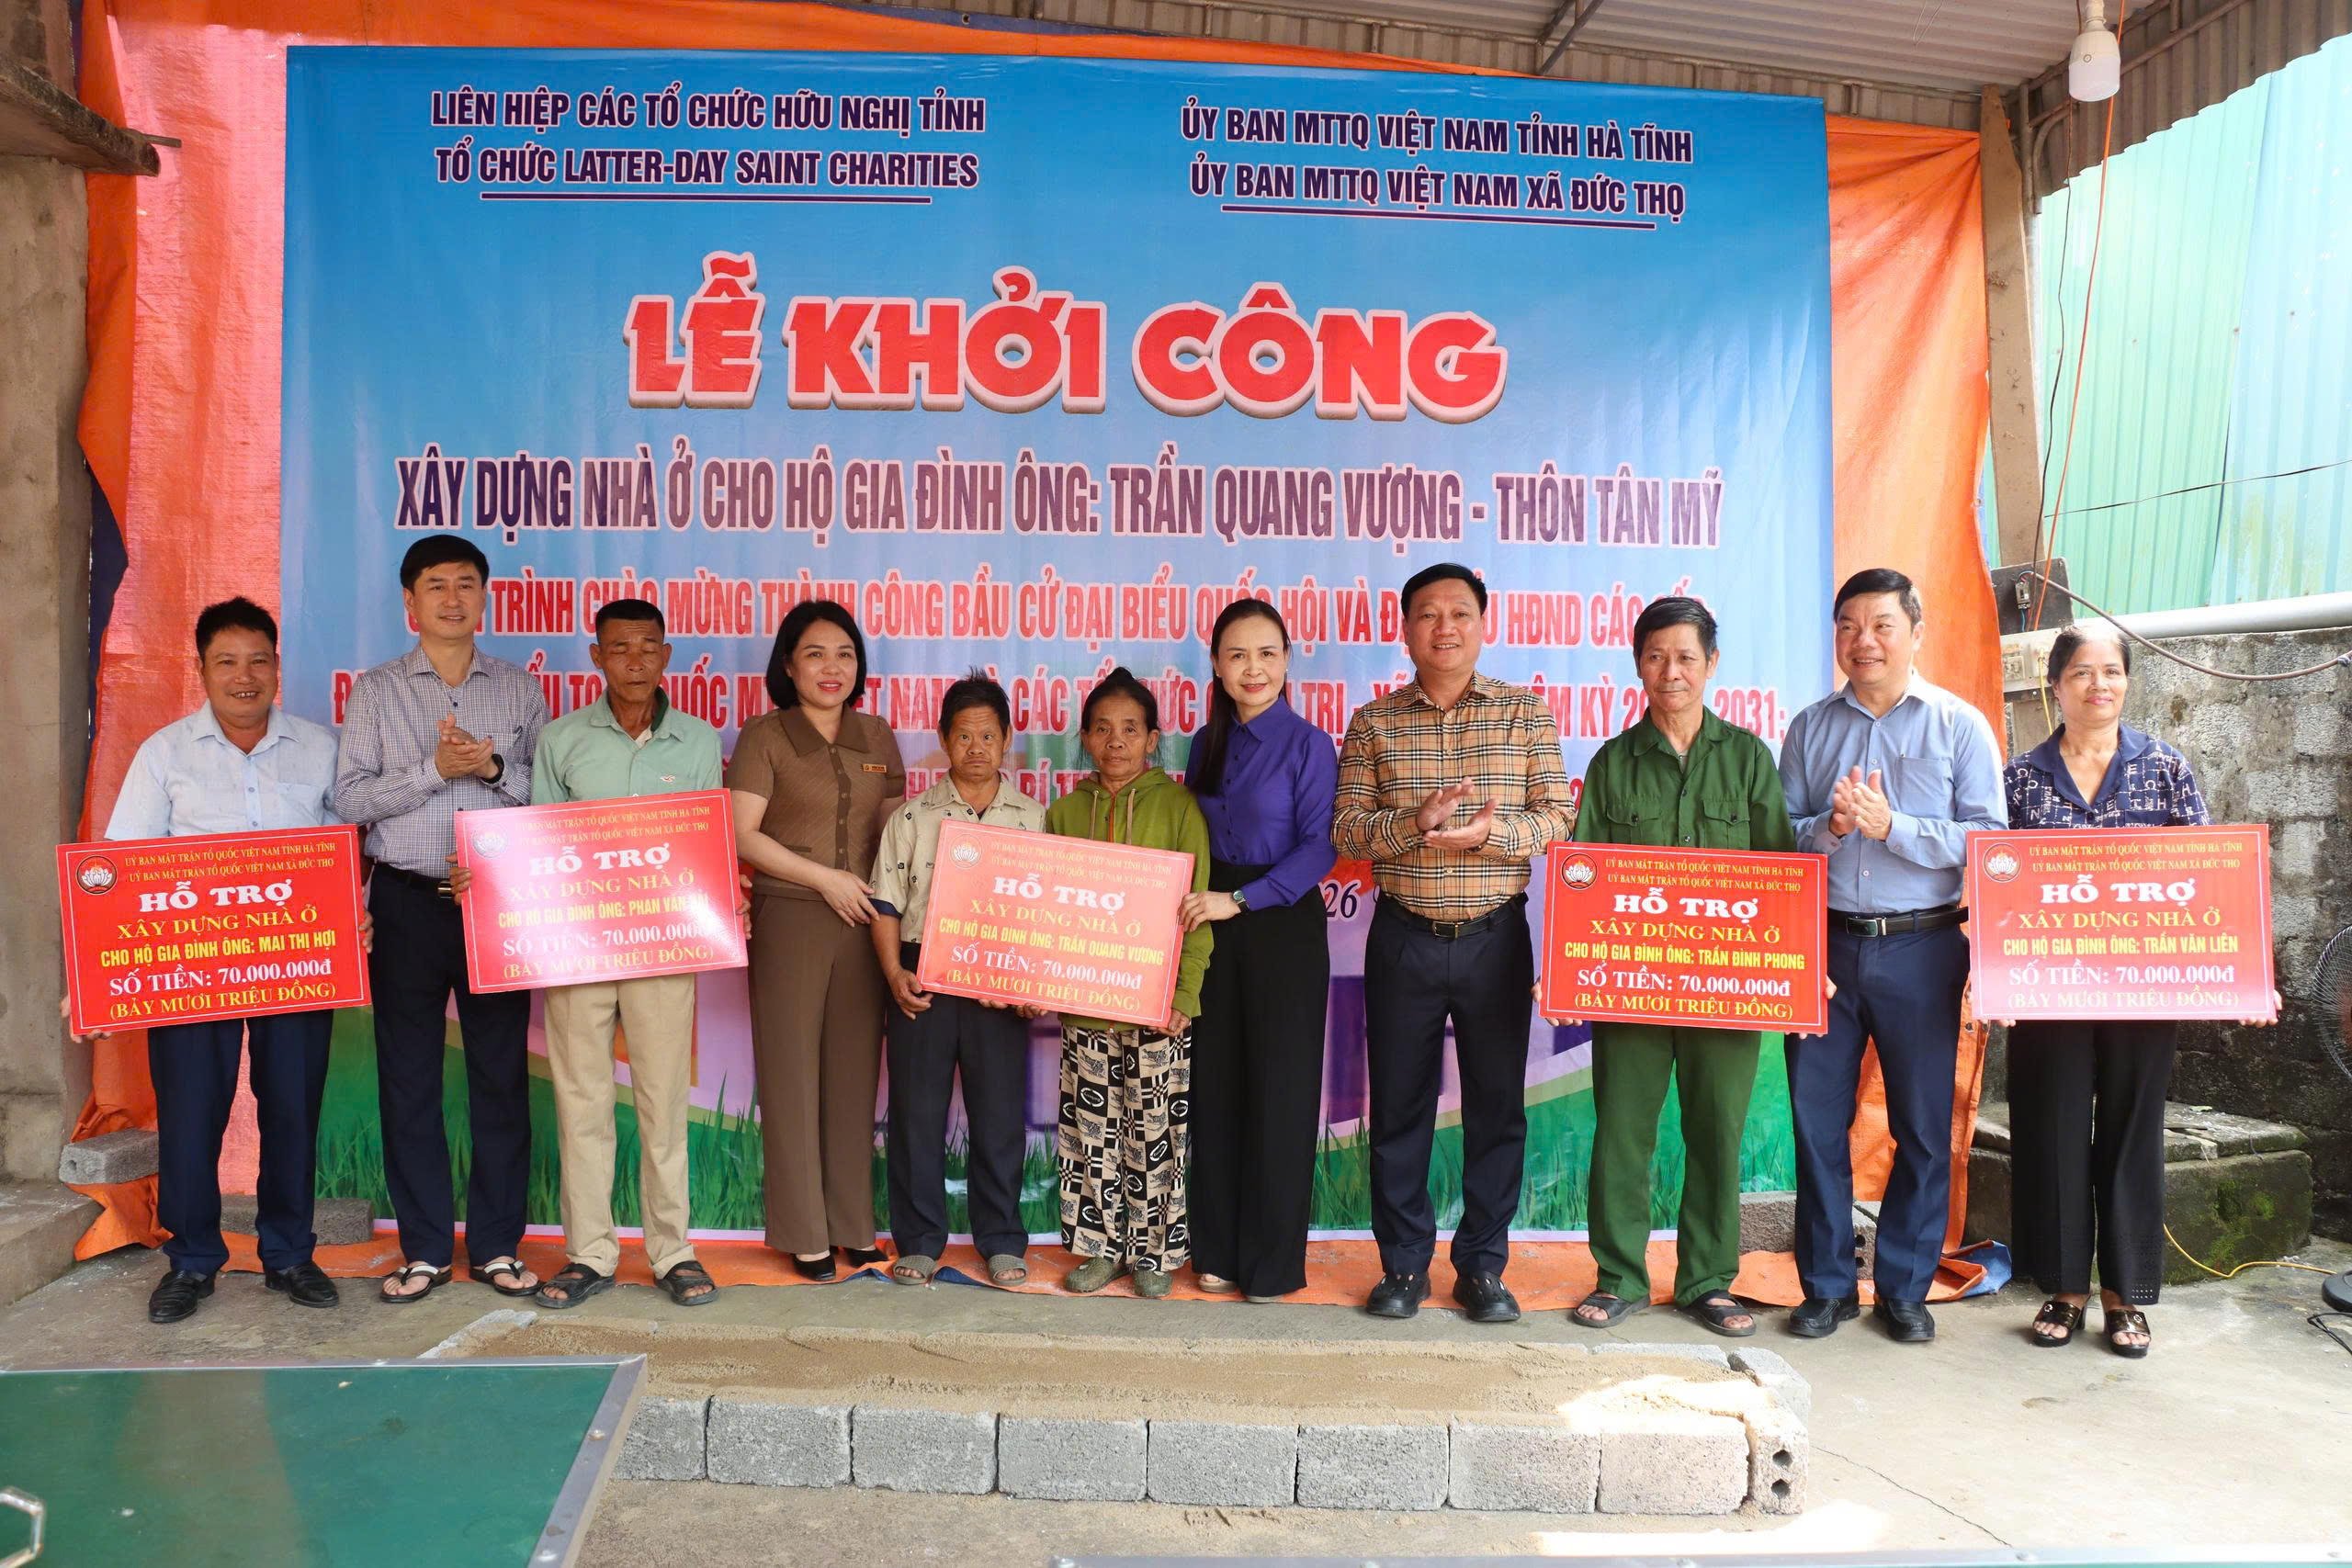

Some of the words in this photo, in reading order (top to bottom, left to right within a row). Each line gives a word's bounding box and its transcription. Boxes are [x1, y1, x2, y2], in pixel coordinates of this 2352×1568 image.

[431, 85, 499, 127] LIÊN
[503, 86, 571, 134] HIỆP
[577, 82, 636, 130] CÁC
[643, 80, 683, 130] TỔ
[688, 86, 765, 130] CHỨC
[772, 88, 833, 130] HỮU
[840, 95, 911, 139] NGHỊ
[919, 85, 986, 132] TỈNH
[1182, 95, 1220, 141] ỦY
[1226, 108, 1286, 143] BAN
[1294, 110, 1370, 152] MTTQ
[1376, 108, 1435, 155] VIỆT
[1443, 118, 1510, 154] NAM
[1516, 110, 1579, 158] TỈNH
[1586, 116, 1624, 161] HÀ
[1630, 121, 1693, 164] TĨNH
[434, 135, 472, 184] TỔ
[478, 142, 557, 184] CHỨC
[562, 148, 728, 186] LATTER-DAY
[735, 150, 821, 186] SAINT
[828, 152, 979, 189] CHARITIES
[1190, 152, 1227, 197] ỦY
[1235, 164, 1295, 199] BAN
[1303, 166, 1379, 207] MTTQ
[1385, 164, 1445, 211] VIỆT
[1453, 174, 1520, 209] NAM
[1524, 168, 1564, 210] XÃ
[1569, 172, 1627, 214] ĐỨC
[1633, 182, 1685, 223] THỌ
[625, 251, 761, 407] LỄ
[784, 265, 1107, 412] KHỞI
[1132, 282, 1508, 423] CÔNG
[396, 444, 467, 528] XÂY
[475, 451, 573, 543] DỰNG
[582, 444, 658, 529] NHÀ
[667, 436, 695, 530] Ở
[701, 459, 774, 531] CHO
[784, 445, 835, 547] HỘ
[845, 461, 907, 532] GIA
[913, 446, 1005, 533] ĐÌNH
[1013, 448, 1101, 536] ÔNG:
[1108, 441, 1205, 536] TRẦN
[1213, 467, 1332, 544] QUANG
[1342, 463, 1463, 555] VƯỢNG
[1493, 461, 1587, 544] THÔN
[1594, 462, 1663, 547] TÂN
[1669, 467, 1726, 548] MỸ
[489, 567, 575, 636] TRÌNH
[666, 568, 755, 637] MỪNG
[863, 569, 944, 639] CÔNG
[952, 563, 1011, 639] BẦU
[1018, 563, 1062, 640] CỬ
[1064, 582, 1114, 652] ĐẠI
[1120, 562, 1188, 641] BIỂU
[1280, 576, 1329, 655] HỘI
[1334, 577, 1374, 644] VÀ
[1011, 665, 1070, 733] CÁC
[1578, 674, 1617, 739] KỲ
[526, 846, 582, 878] HỖ
[593, 843, 670, 870] TRỢ
[1618, 859, 1634, 868] BAN
[1732, 864, 1750, 874] NAM
[140, 881, 198, 912] HỖ
[209, 879, 292, 906] TRỢ
[628, 868, 673, 890] NHÀ
[678, 868, 694, 887] Ở
[993, 873, 1043, 898] HỖ
[1054, 886, 1125, 915] TRỢ
[2041, 874, 2098, 903] HỖ
[2110, 878, 2195, 906] TRỢ
[970, 898, 1011, 917] XÂY
[1016, 907, 1071, 926] DỰNG
[1078, 915, 1118, 933] NHÀ
[1126, 919, 1140, 937] Ở
[1323, 880, 1359, 919] 26
[1614, 887, 1668, 914] HỖ
[1679, 898, 1758, 923] TRỢ
[118, 919, 165, 939] XÂY
[174, 915, 238, 935] DỰNG
[246, 907, 294, 927] NHÀ
[301, 905, 317, 922] Ở
[1590, 918, 1636, 935] XÂY
[1643, 923, 1703, 941] DỰNG
[1712, 925, 1757, 942] NHÀ
[1764, 926, 1780, 942] Ở
[2019, 909, 2065, 928] XÂY
[2073, 911, 2139, 931] DỰNG
[2146, 908, 2196, 926] NHÀ
[2203, 907, 2220, 926] Ở
[101, 950, 129, 966] CHO
[134, 944, 153, 969] HỘ
[157, 945, 181, 962] GIA
[185, 940, 218, 959] ĐÌNH
[222, 937, 254, 955] ÔNG:
[259, 935, 285, 952] MAI
[288, 933, 310, 952] THỊ
[313, 930, 335, 950] HỢI
[601, 948, 652, 974] TRIỆU
[659, 938, 714, 963] ĐỒNG)
[1566, 942, 1588, 958] CHO
[1592, 941, 1608, 964] HỘ
[1611, 944, 1631, 960] GIA
[1634, 943, 1662, 962] ĐÌNH
[1667, 944, 1694, 964] ÔNG:
[1698, 945, 1728, 965] TRẦN
[1732, 950, 1760, 967] ĐÌNH
[1764, 953, 1804, 969] PHONG
[2004, 939, 2028, 955] CHO
[2032, 935, 2048, 960] HỘ
[2052, 939, 2073, 955] GIA
[2076, 935, 2107, 954] ĐÌNH
[2110, 934, 2140, 954] ÔNG:
[2143, 931, 2177, 953] TRẦN
[2180, 933, 2206, 953] VĂN
[2210, 933, 2238, 953] LIÊN
[110, 968, 141, 996] SỐ
[147, 964, 211, 991] TIỀN:
[218, 959, 331, 984] 70.000.000đ
[952, 942, 979, 964] SỐ
[984, 947, 1036, 974] TIỀN:
[1044, 961, 1142, 989] 70.000.000đ
[1577, 962, 1607, 987] SỐ
[1613, 964, 1672, 990] TIỀN:
[1679, 976, 1791, 996] 70.000.000đ
[2008, 959, 2041, 987] SỐ
[2045, 958, 2109, 986] TIỀN:
[2116, 965, 2234, 986] 70.000.000đ
[110, 998, 153, 1020] (BẢY
[161, 993, 211, 1012] MƯƠI
[217, 987, 272, 1007] TRIỆU
[278, 979, 335, 1000] ĐỒNG)
[1575, 990, 1616, 1008] (BẢY
[1623, 995, 1670, 1011] MƯƠI
[1676, 997, 1730, 1017] TRIỆU
[1735, 997, 1792, 1020] ĐỒNG)
